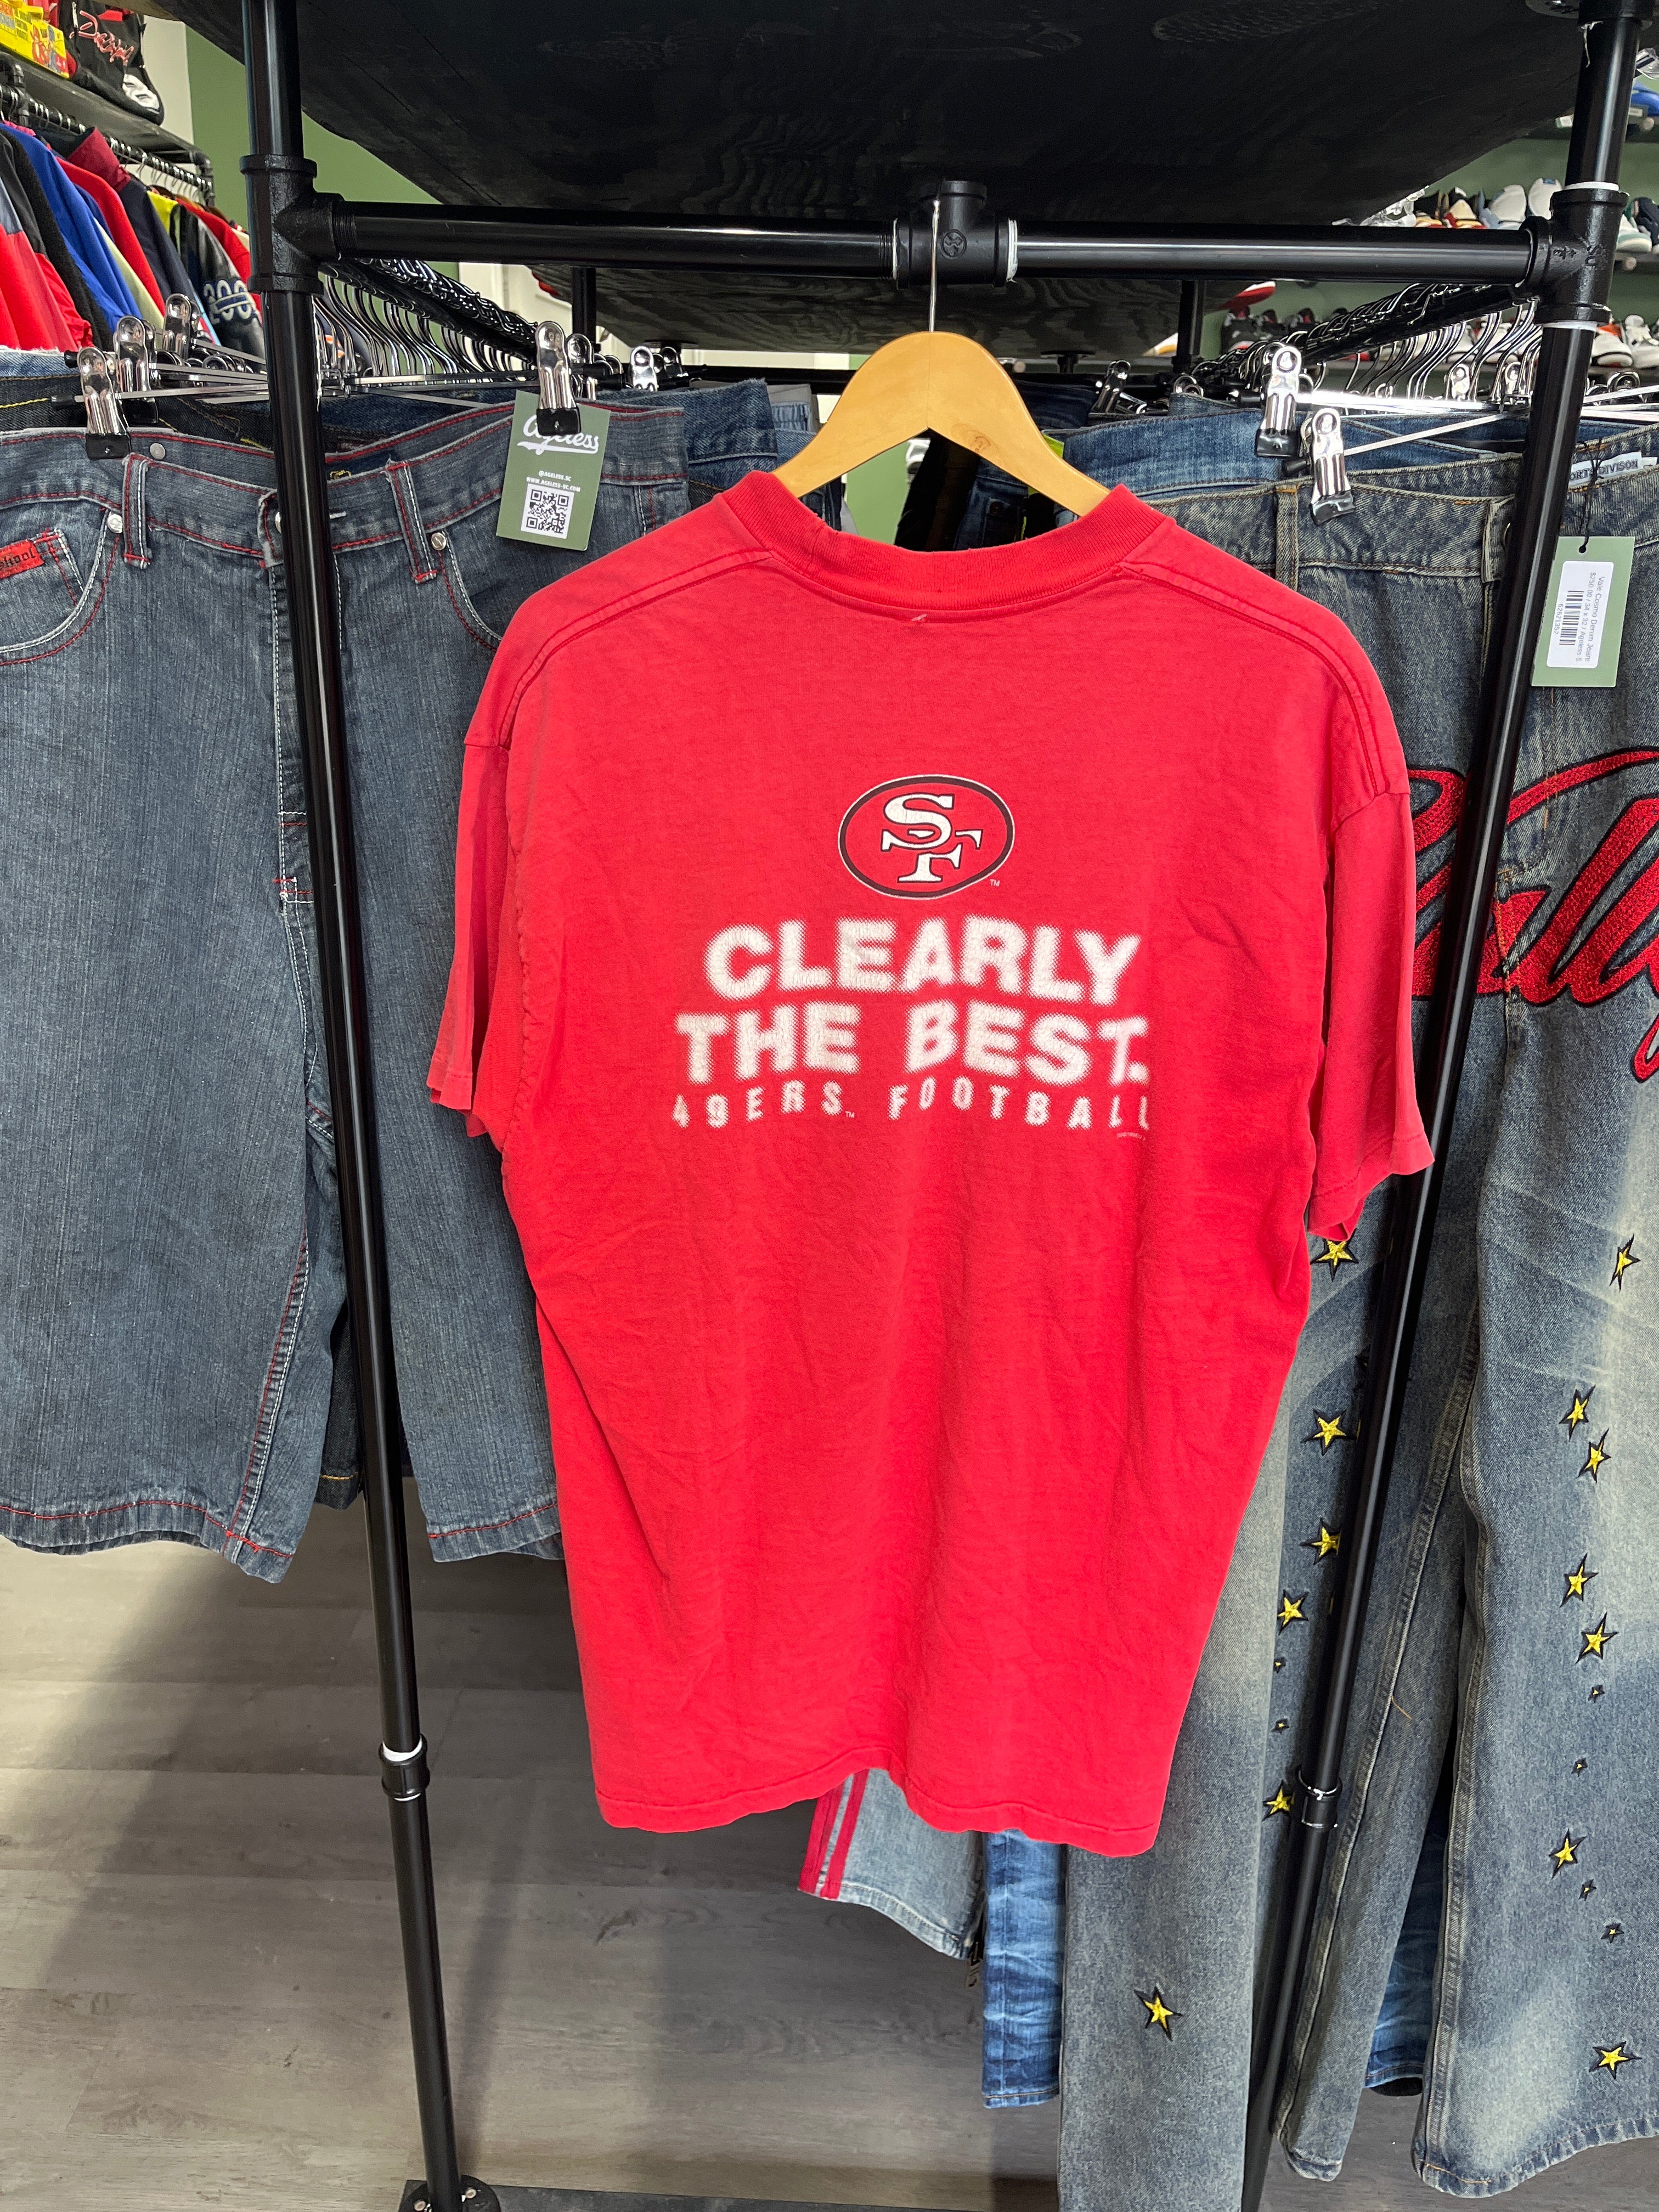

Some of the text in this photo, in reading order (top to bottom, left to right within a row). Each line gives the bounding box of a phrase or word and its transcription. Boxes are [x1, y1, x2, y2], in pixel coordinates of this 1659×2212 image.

[538, 470, 572, 482] @AGELESS.SC
[1598, 459, 1638, 475] DIVISON
[526, 476, 581, 492] WWW.AGELESS-SC.COM
[1592, 593, 1602, 618] Cosmo
[1553, 603, 1564, 635] 62621352
[1588, 619, 1598, 641] Denim
[1577, 631, 1586, 656] Ageless
[879, 792, 983, 884] SF
[989, 878, 1000, 887] TM
[703, 913, 1142, 1007] CLEARLY
[674, 1000, 864, 1085] THE
[671, 1079, 844, 1129] 49ERS
[887, 1075, 1150, 1131] FOOTBALL
